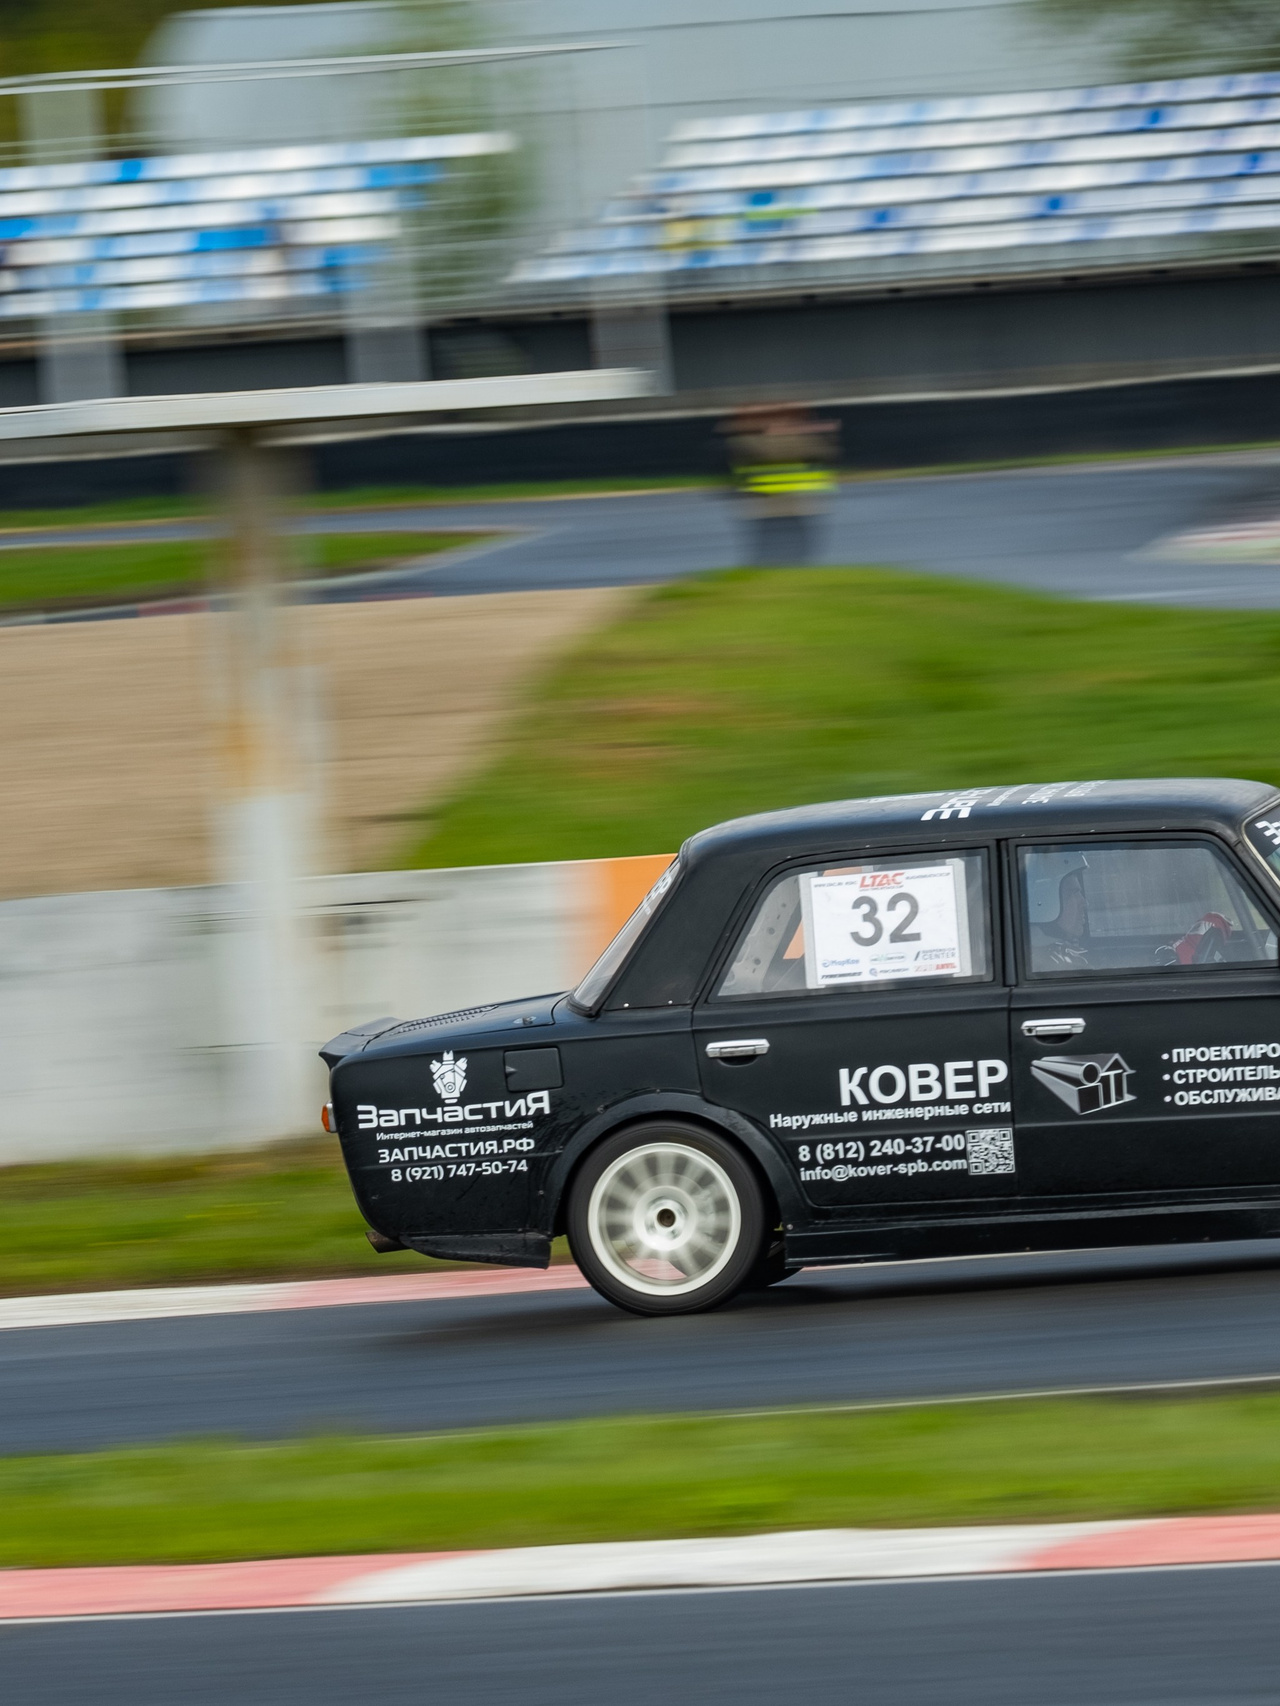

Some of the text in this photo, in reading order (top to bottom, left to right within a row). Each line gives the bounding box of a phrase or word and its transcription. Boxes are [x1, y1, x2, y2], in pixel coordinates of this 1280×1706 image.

[859, 872, 904, 888] LTAC
[850, 892, 922, 947] 32
[838, 1059, 1009, 1106] КОВЕР
[769, 1101, 1011, 1129] Наружные инженерные сети
[376, 1121, 534, 1141] Интернет-магазин автозапчастей
[378, 1138, 536, 1164] ЗАПЧАСТИЯ.РФ
[798, 1133, 966, 1164] 8 (812) 240-37-00
[390, 1159, 528, 1182] 8 (921) 747-50-74
[800, 1158, 967, 1182] info@kover-spb.com
